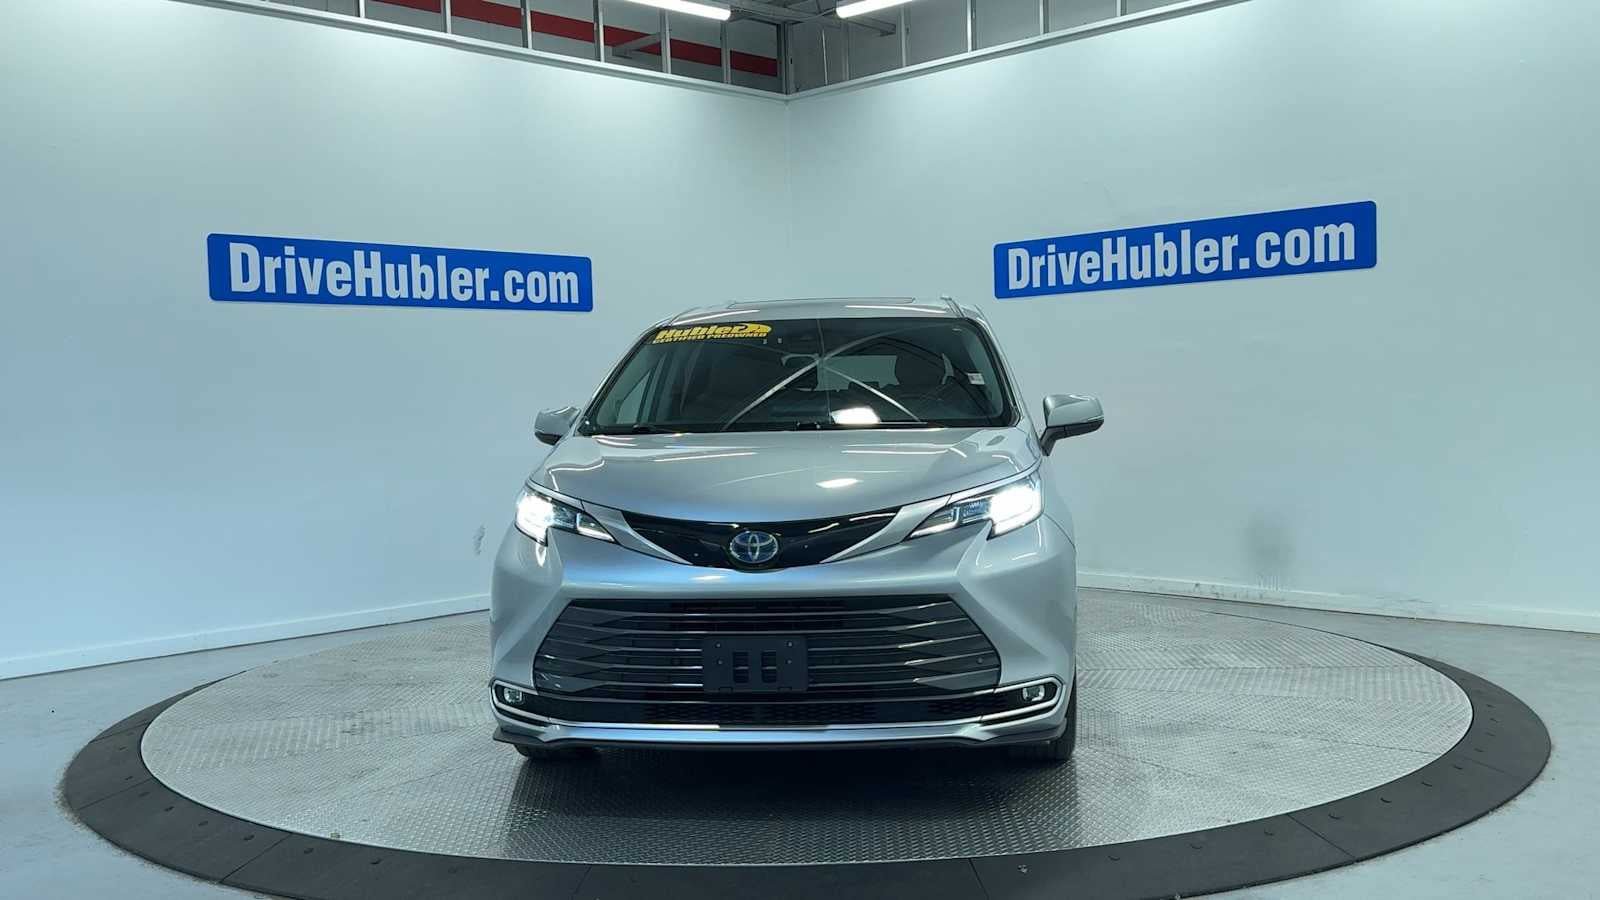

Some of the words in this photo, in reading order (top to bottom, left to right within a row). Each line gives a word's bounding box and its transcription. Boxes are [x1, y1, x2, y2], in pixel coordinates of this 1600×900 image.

[229, 241, 580, 304] DriveHubler.com
[1008, 220, 1355, 291] DriveHubler.com
[655, 324, 747, 340] Hubler
